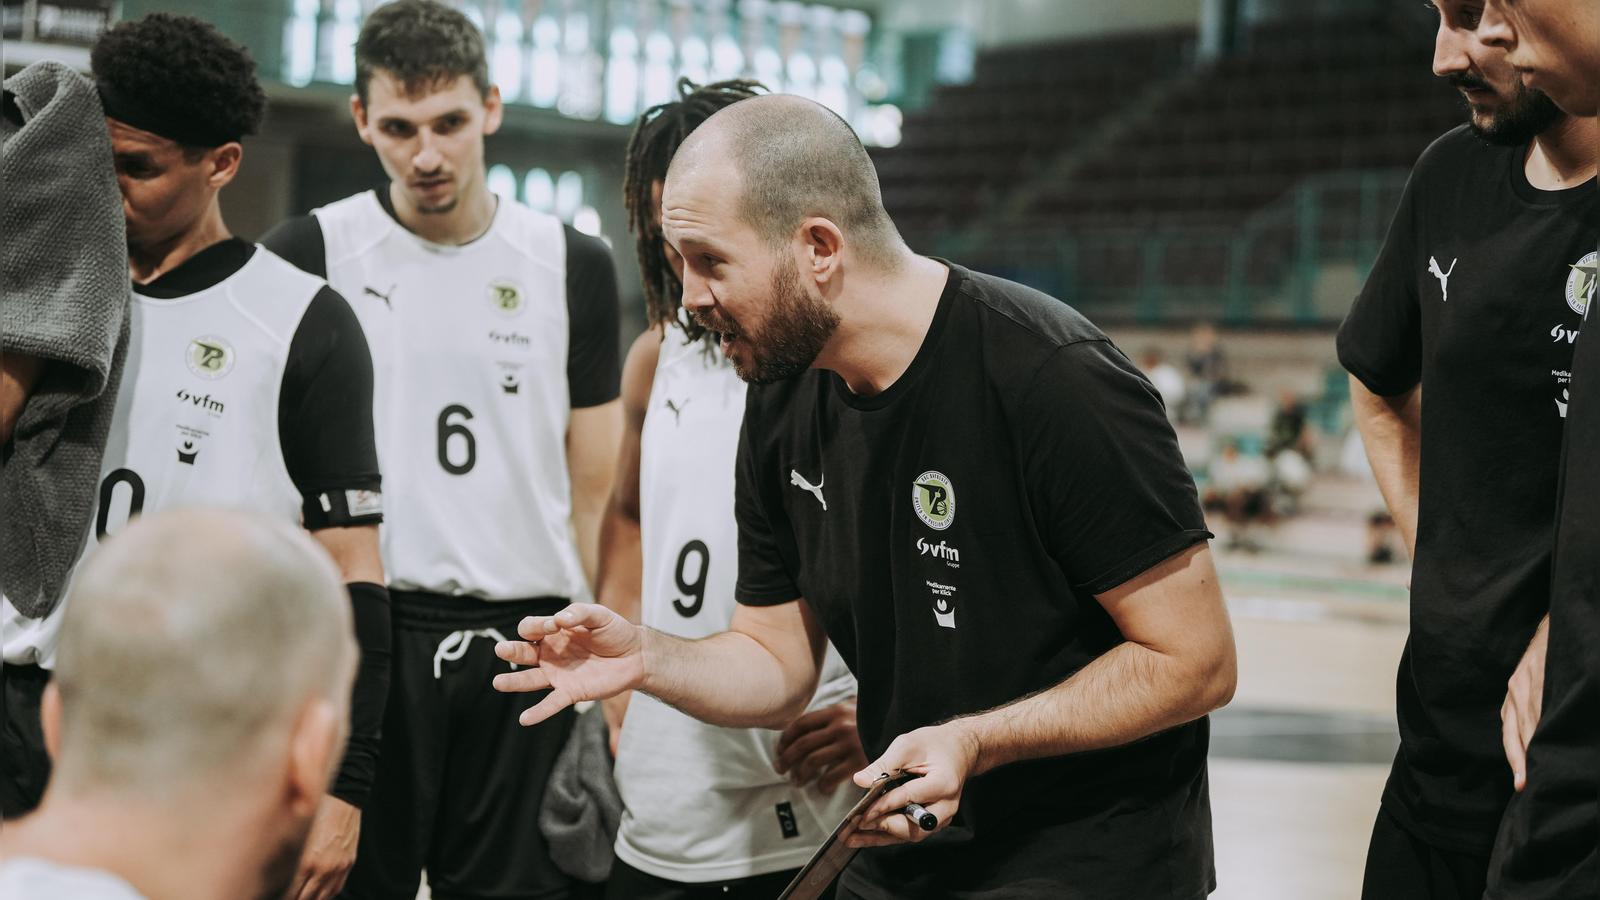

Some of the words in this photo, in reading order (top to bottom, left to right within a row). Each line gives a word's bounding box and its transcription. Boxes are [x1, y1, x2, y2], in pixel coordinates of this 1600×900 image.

[192, 394, 225, 413] vfm
[438, 404, 476, 475] 6
[929, 540, 960, 562] vfm
[672, 540, 710, 618] 9
